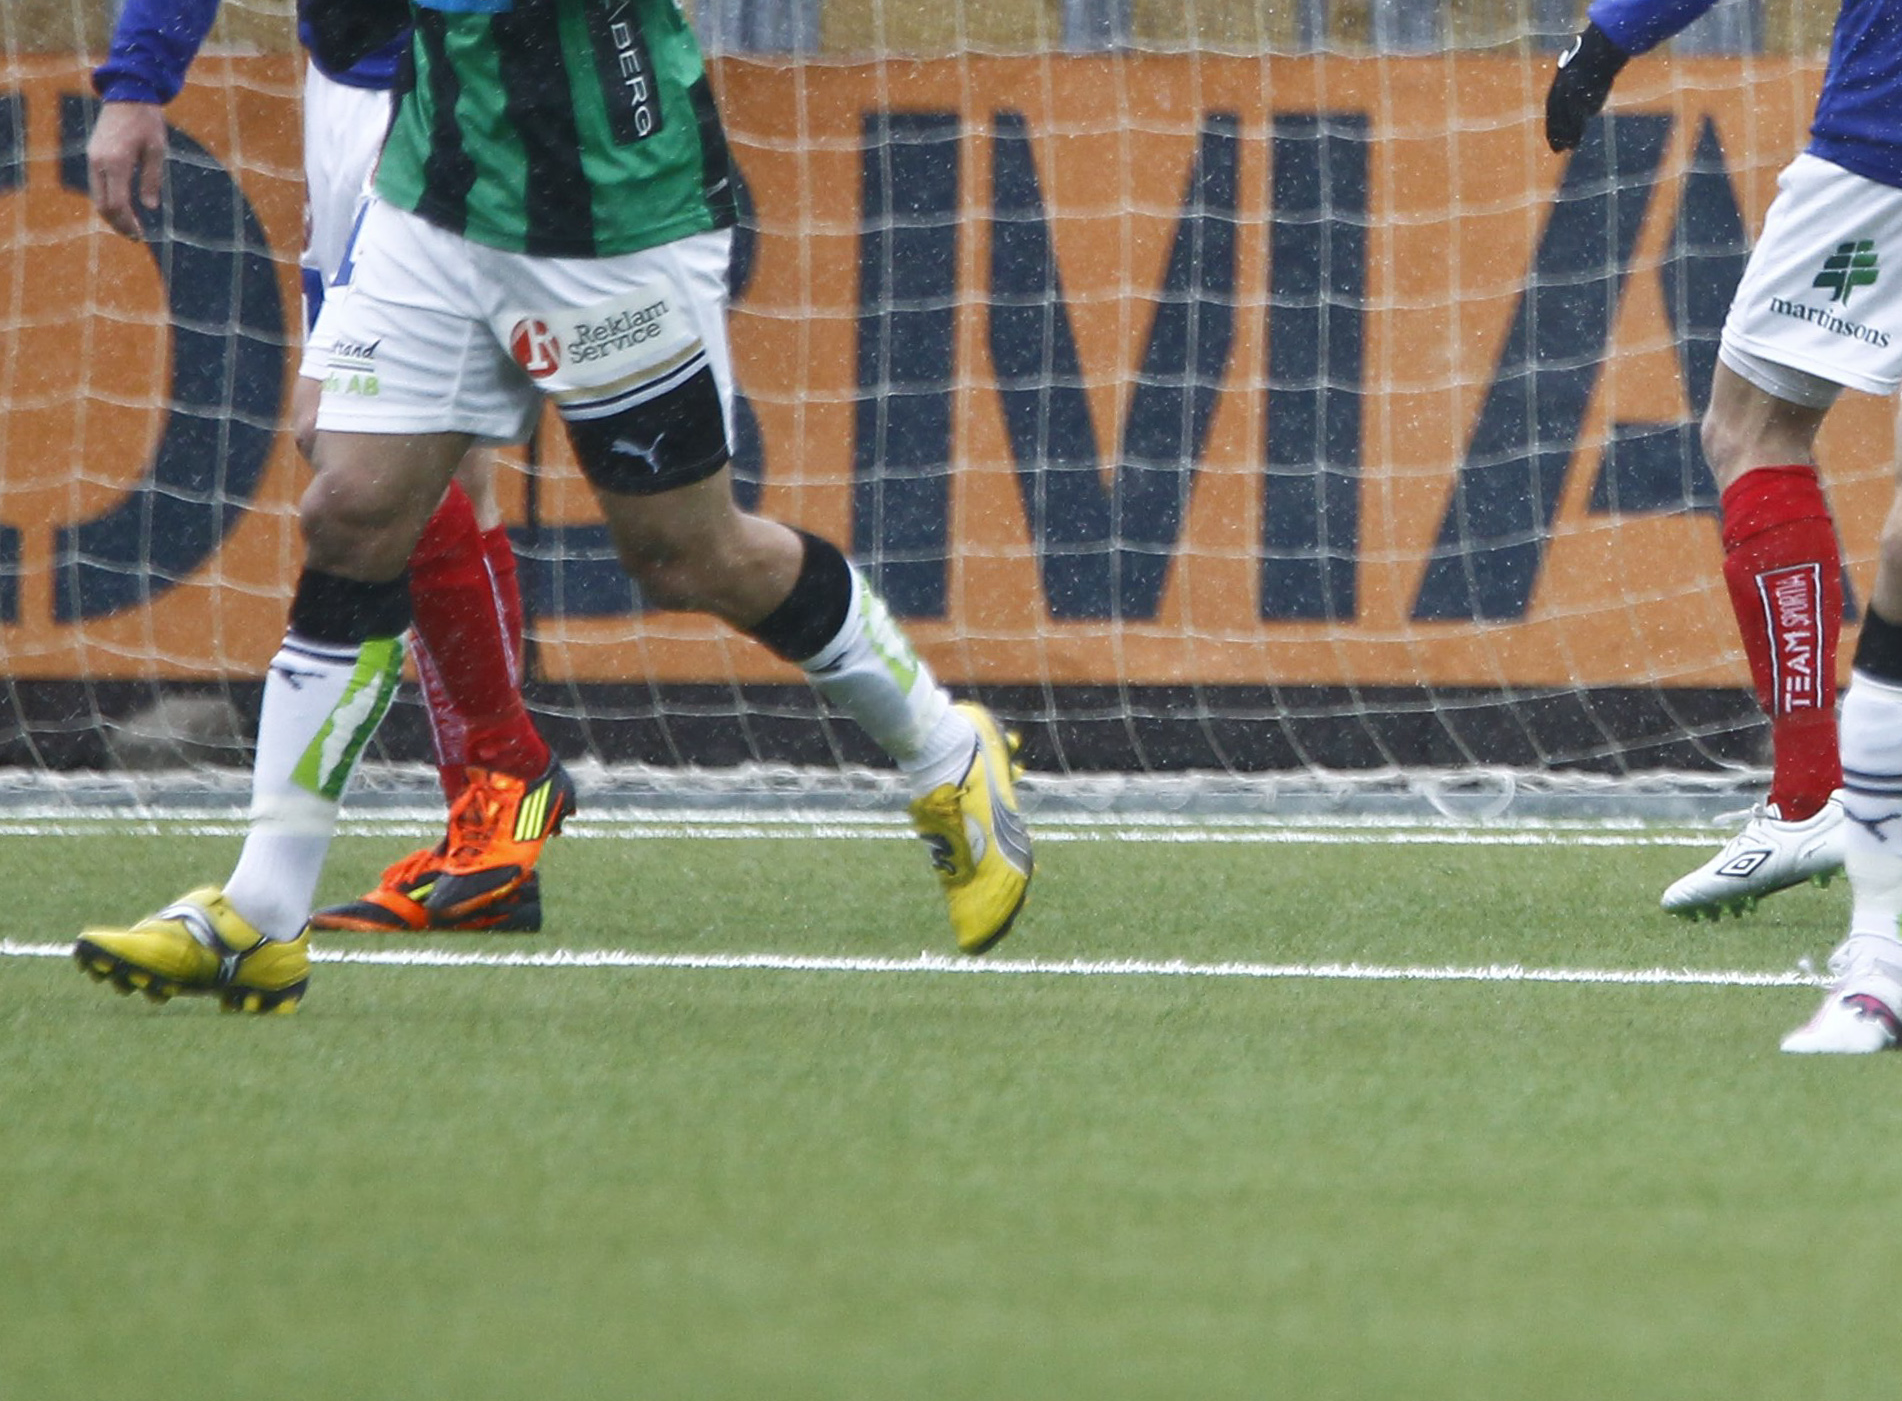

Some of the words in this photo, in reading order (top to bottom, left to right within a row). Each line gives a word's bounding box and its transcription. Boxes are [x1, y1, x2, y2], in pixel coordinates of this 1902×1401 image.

[568, 322, 661, 364] Service
[573, 300, 669, 346] Reklam
[1769, 296, 1892, 349] martinsons
[1783, 630, 1811, 713] TEAM
